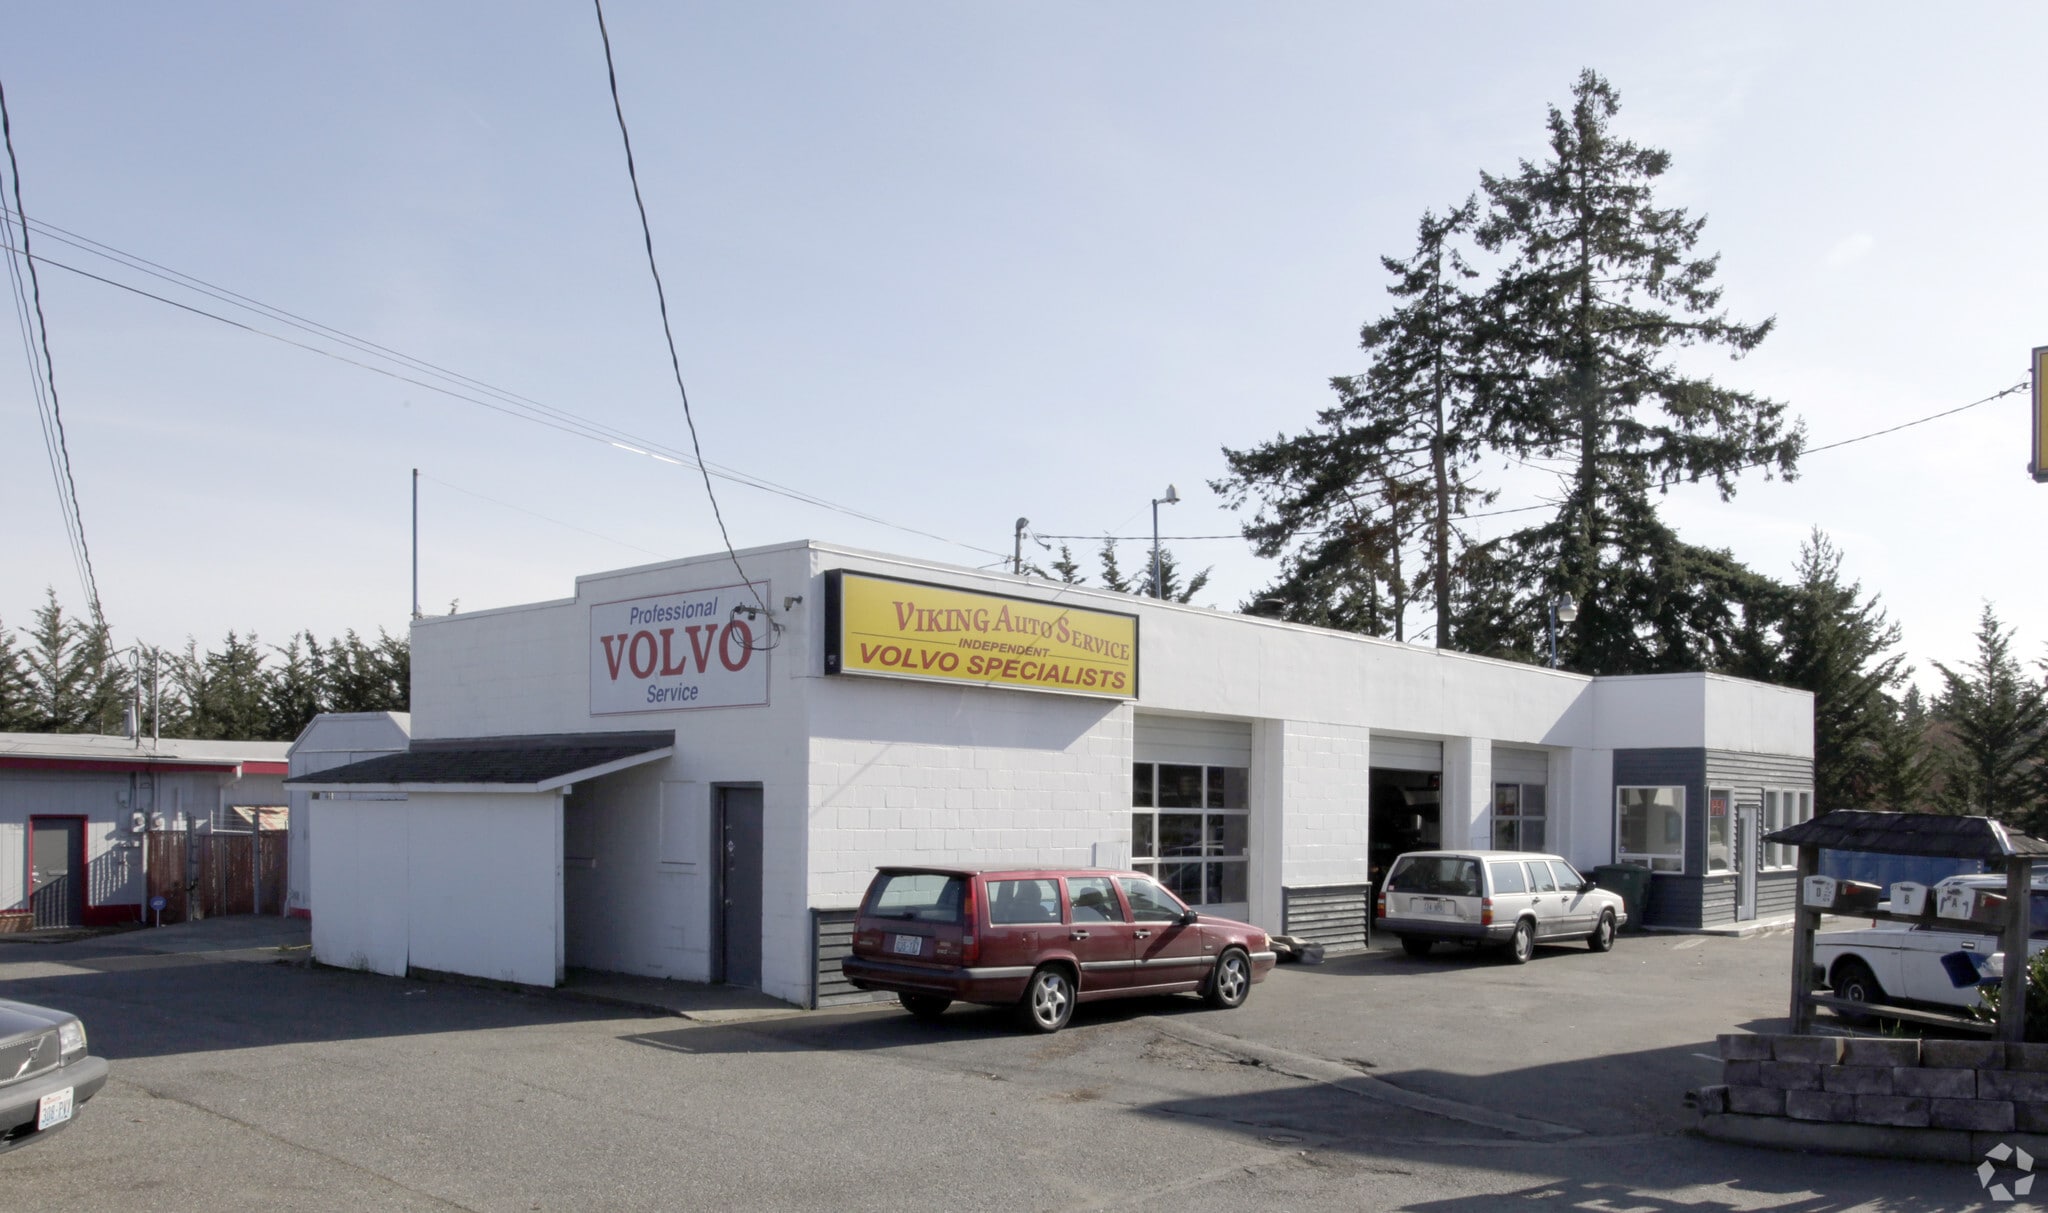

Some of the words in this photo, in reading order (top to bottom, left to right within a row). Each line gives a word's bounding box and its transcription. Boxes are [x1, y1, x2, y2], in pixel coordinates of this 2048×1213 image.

[630, 597, 718, 625] Professional
[892, 601, 990, 634] VIKING
[1056, 616, 1130, 660] SERVICE
[958, 638, 1050, 658] INDEPENDENT
[600, 620, 753, 681] VOLVO
[860, 643, 960, 672] VOLVO
[966, 655, 1126, 689] SPECIALISTS
[646, 682, 699, 703] Service
